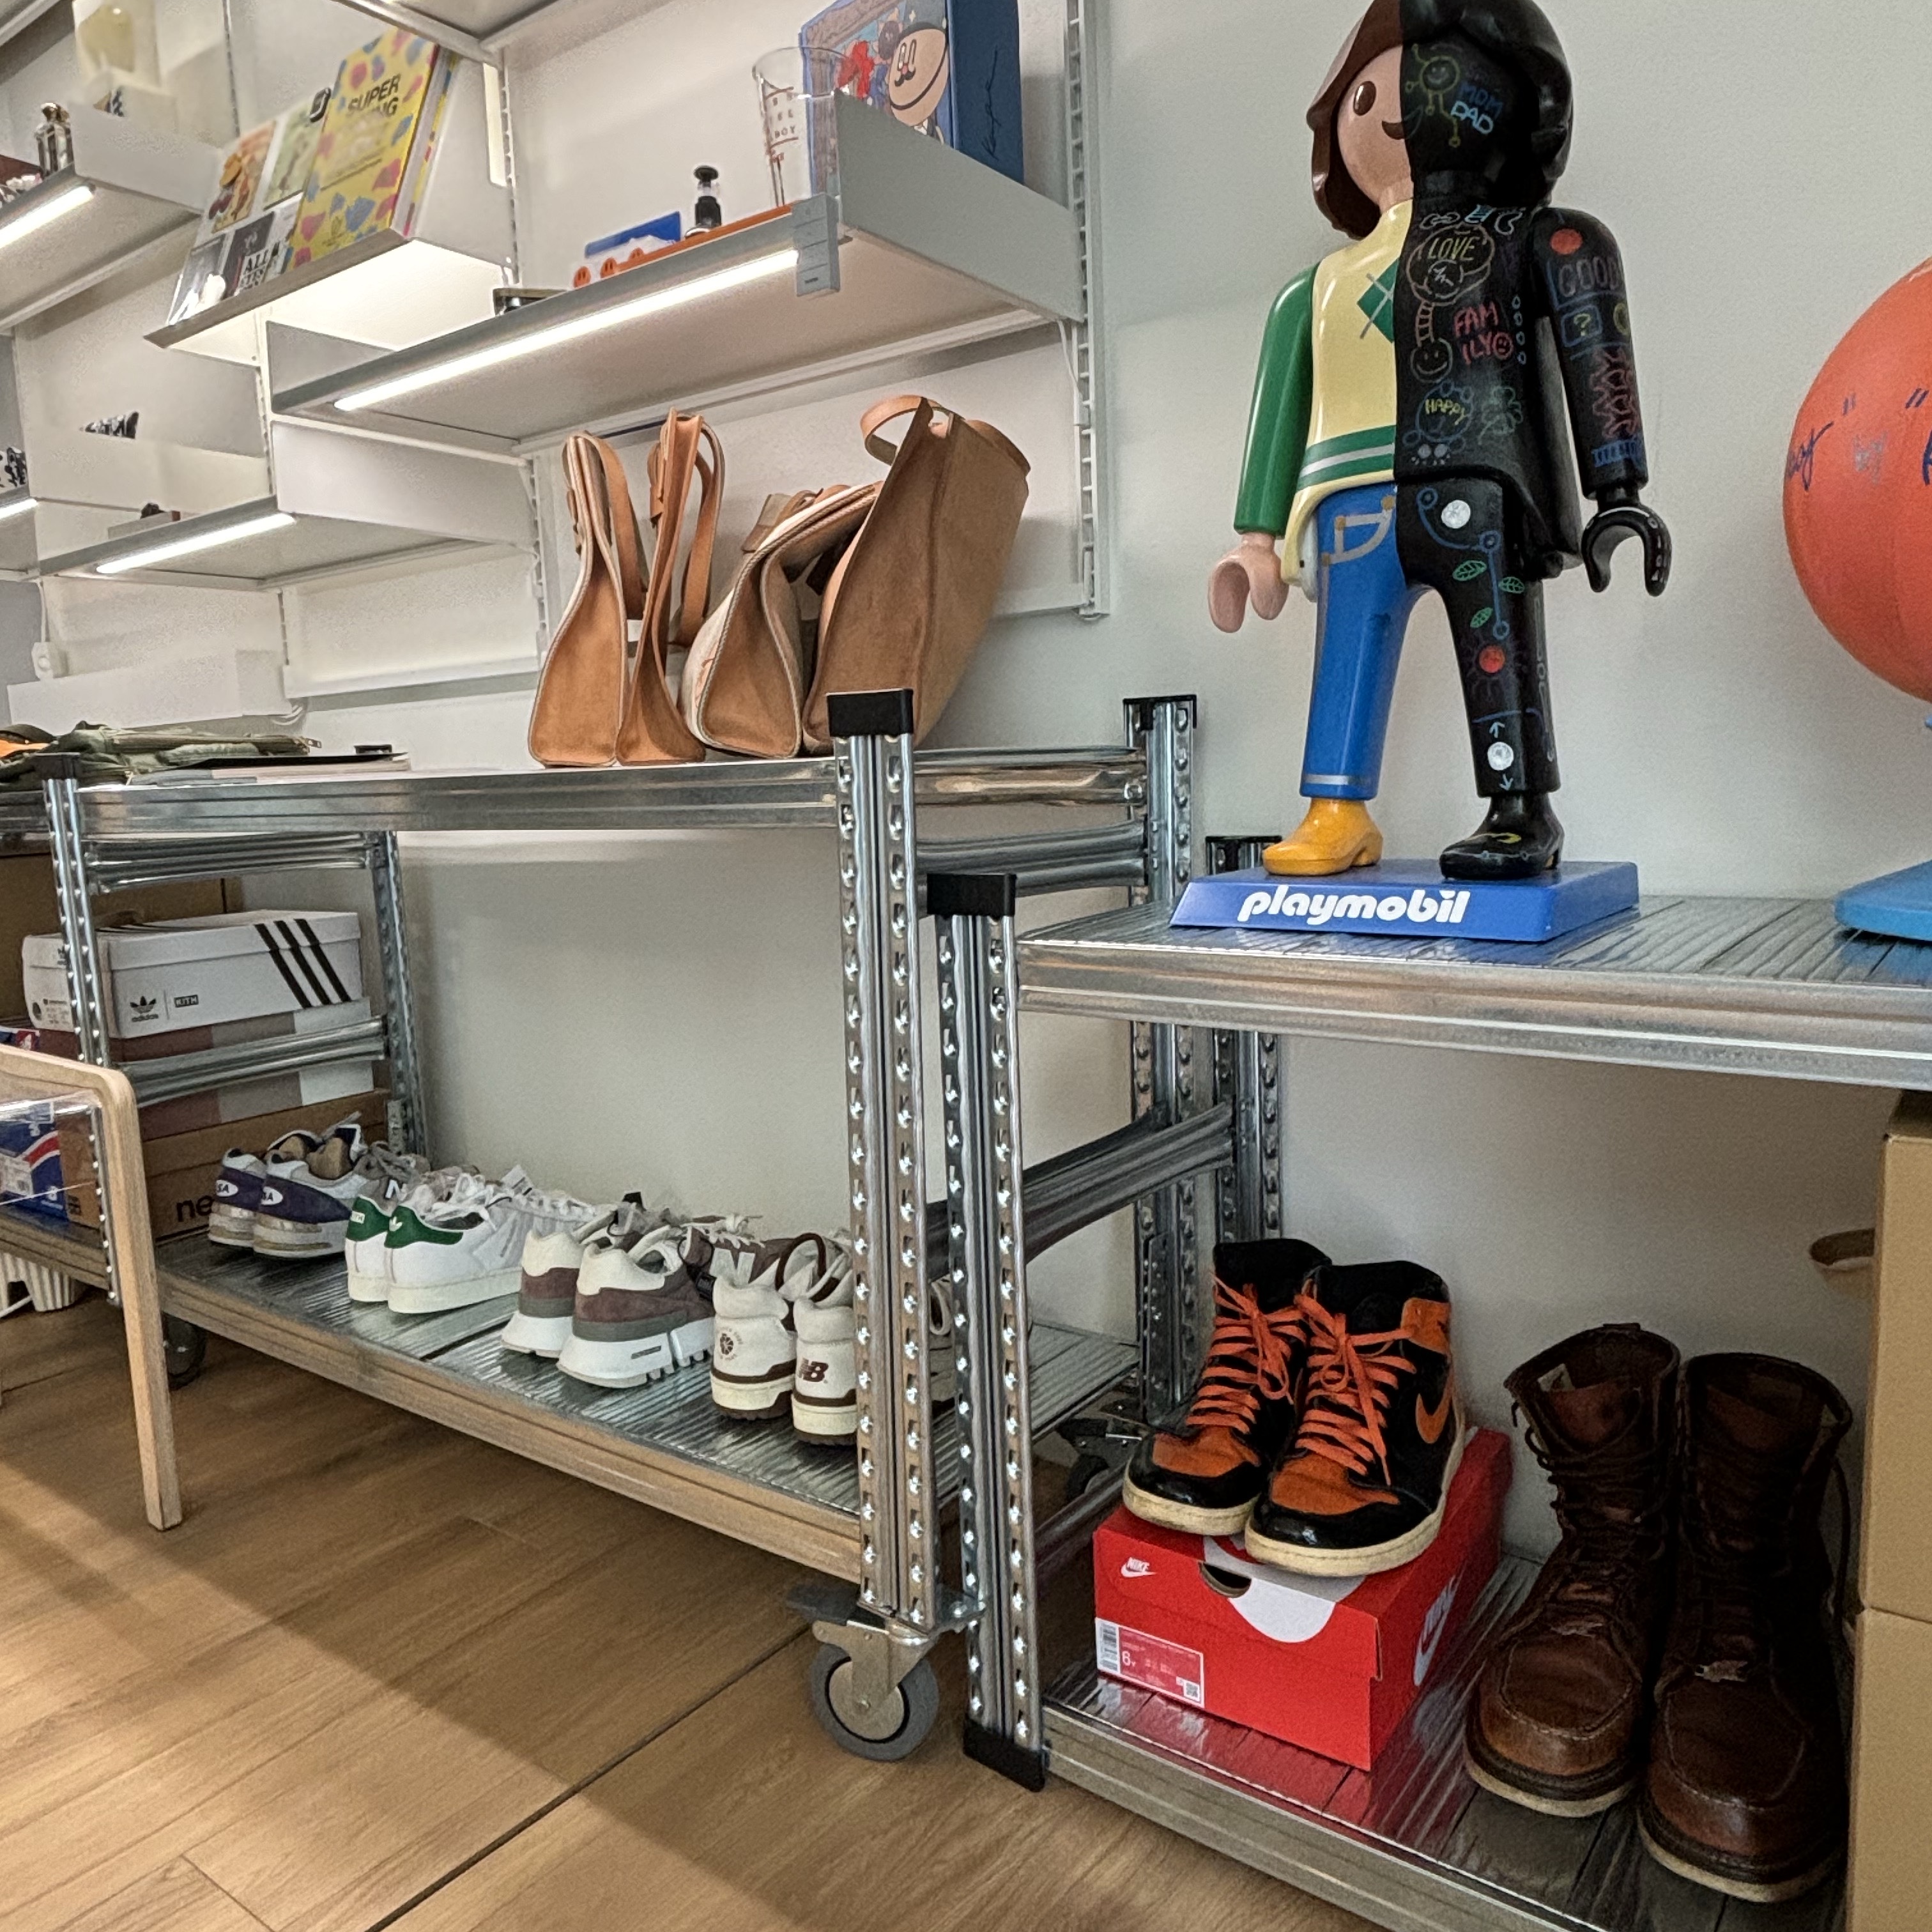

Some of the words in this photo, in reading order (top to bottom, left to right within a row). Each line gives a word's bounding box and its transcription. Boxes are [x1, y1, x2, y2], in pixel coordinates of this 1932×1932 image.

[348, 73, 401, 111] SUPER
[1450, 100, 1494, 134] DAD
[1427, 236, 1480, 261] LOVE
[1453, 301, 1499, 338] FAM
[1425, 399, 1465, 425] HAPPY
[1237, 884, 1471, 926] playmobil
[176, 996, 198, 1007] KITH
[176, 1195, 215, 1222] ne
[1127, 1556, 1150, 1572] NIKE
